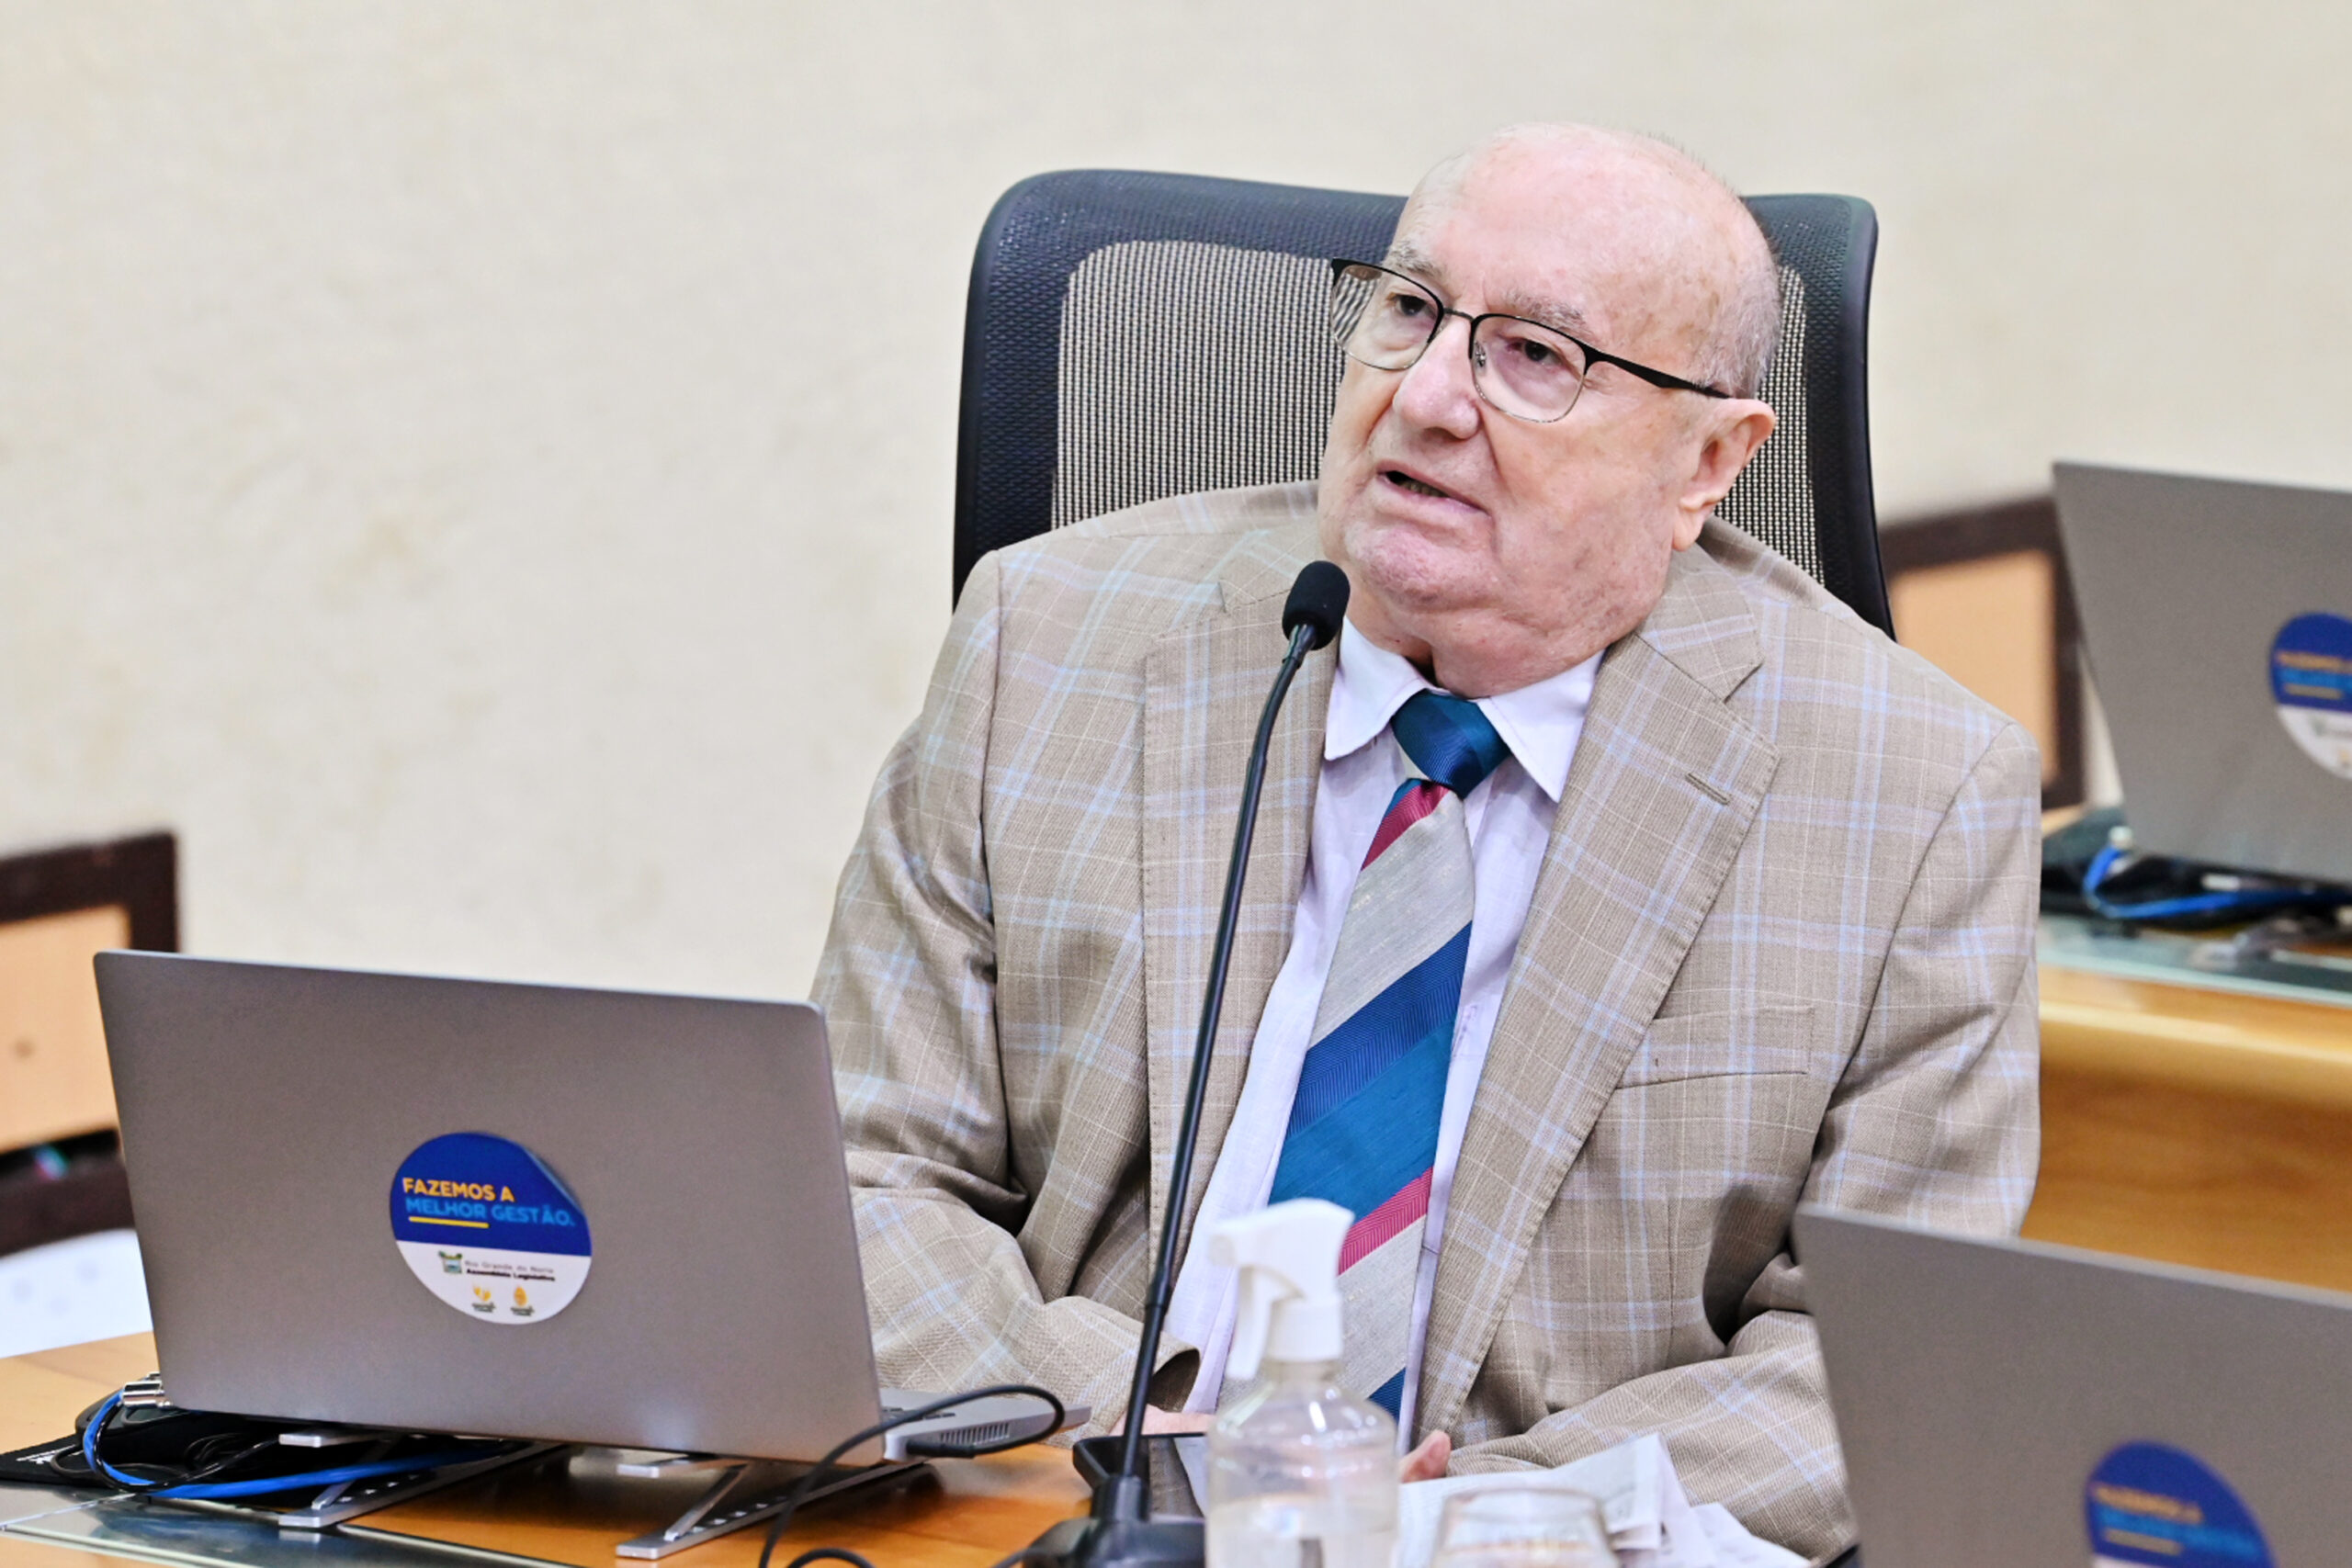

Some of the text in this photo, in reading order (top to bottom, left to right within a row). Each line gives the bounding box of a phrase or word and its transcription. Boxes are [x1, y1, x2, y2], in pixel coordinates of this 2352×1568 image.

[402, 1178, 514, 1202] FAZEMOS A
[405, 1198, 576, 1227] MELHOR GESTÃO.
